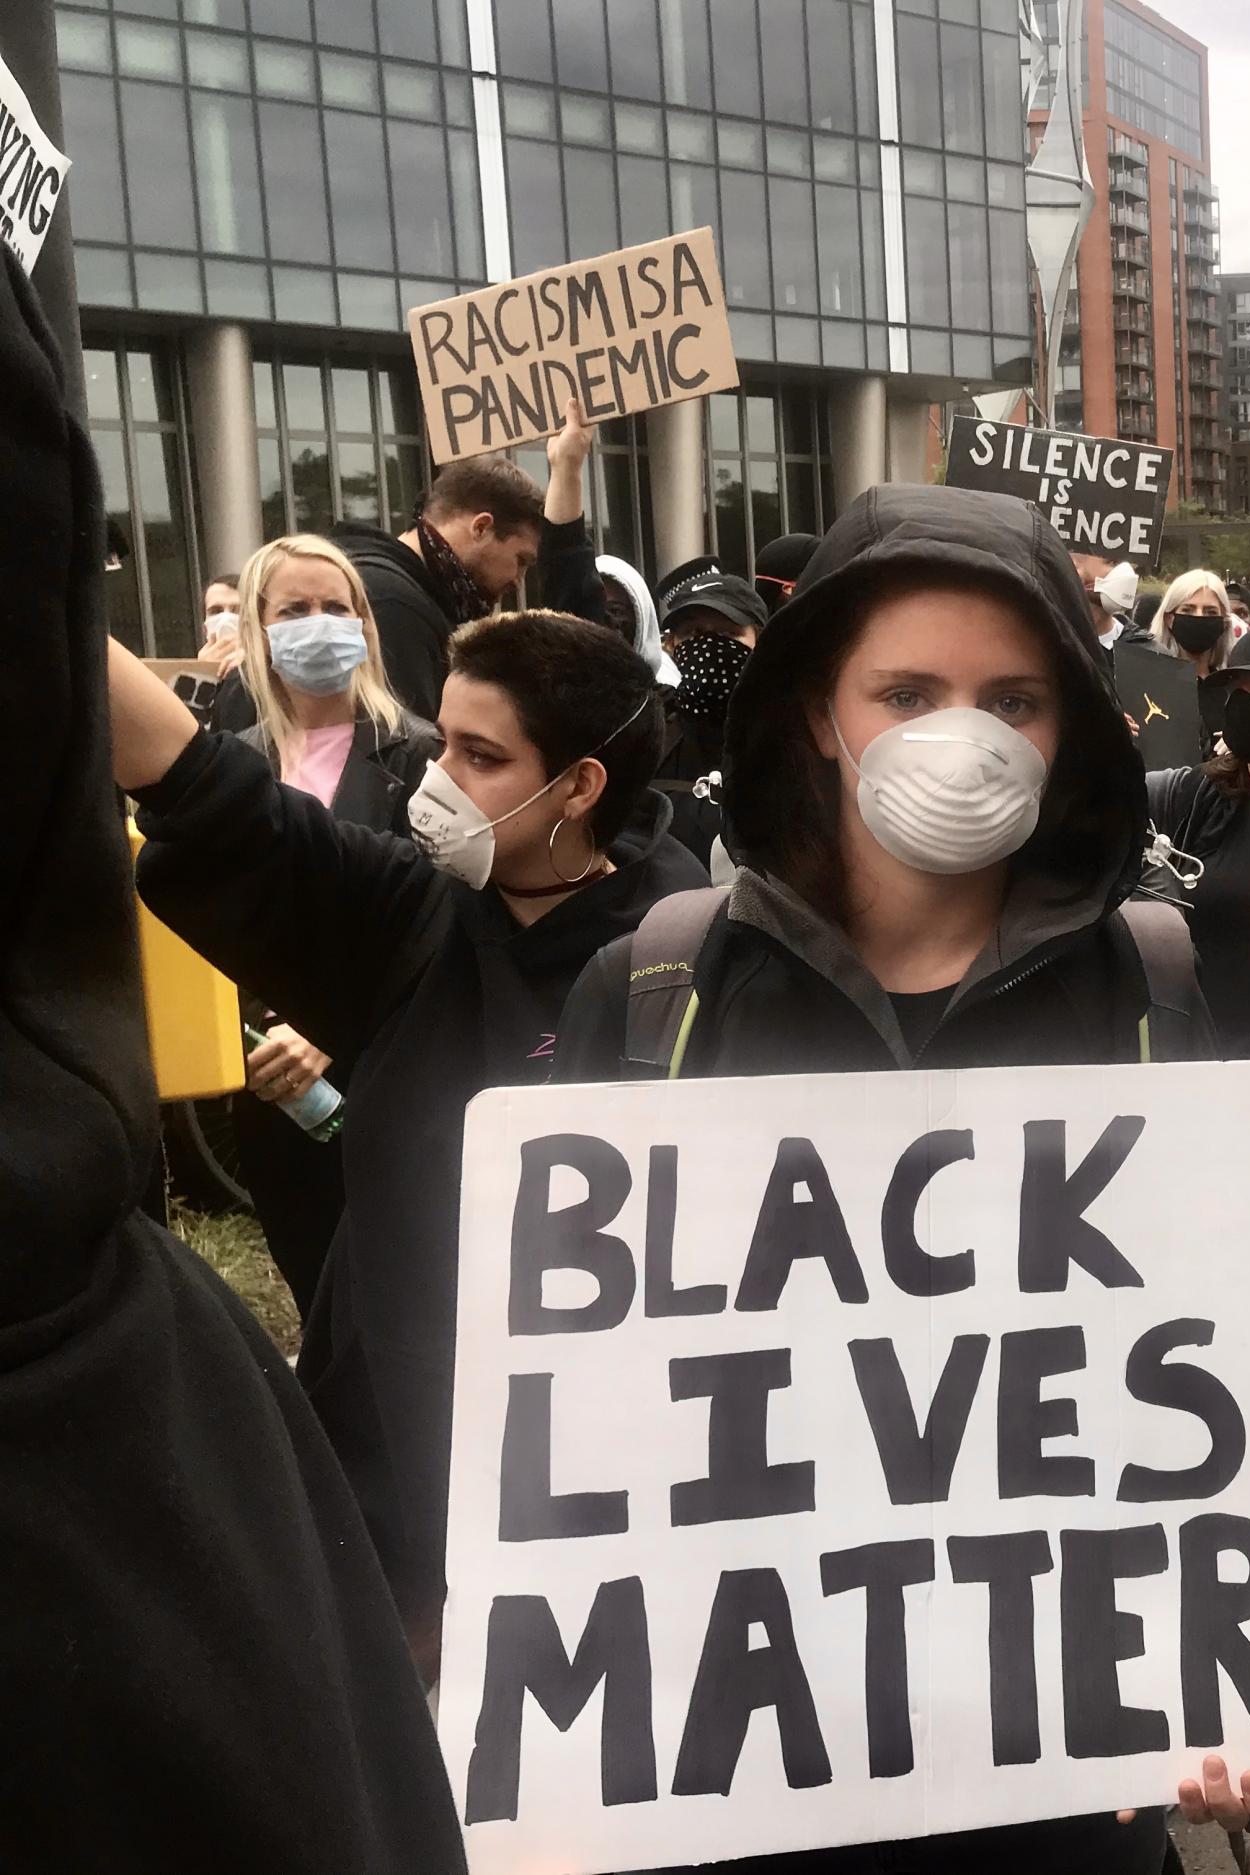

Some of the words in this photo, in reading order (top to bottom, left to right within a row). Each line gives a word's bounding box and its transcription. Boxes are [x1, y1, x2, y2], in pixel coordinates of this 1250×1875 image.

[420, 271, 616, 385] RACISM
[618, 257, 667, 329] IS
[673, 243, 713, 315] A
[442, 323, 710, 455] PANDEMIC
[969, 423, 1163, 493] SILENCE
[1039, 478, 1074, 505] IS
[1051, 506, 1153, 554] ENCE
[508, 1115, 1145, 1336] BLACK
[498, 1318, 1246, 1542] LIVES
